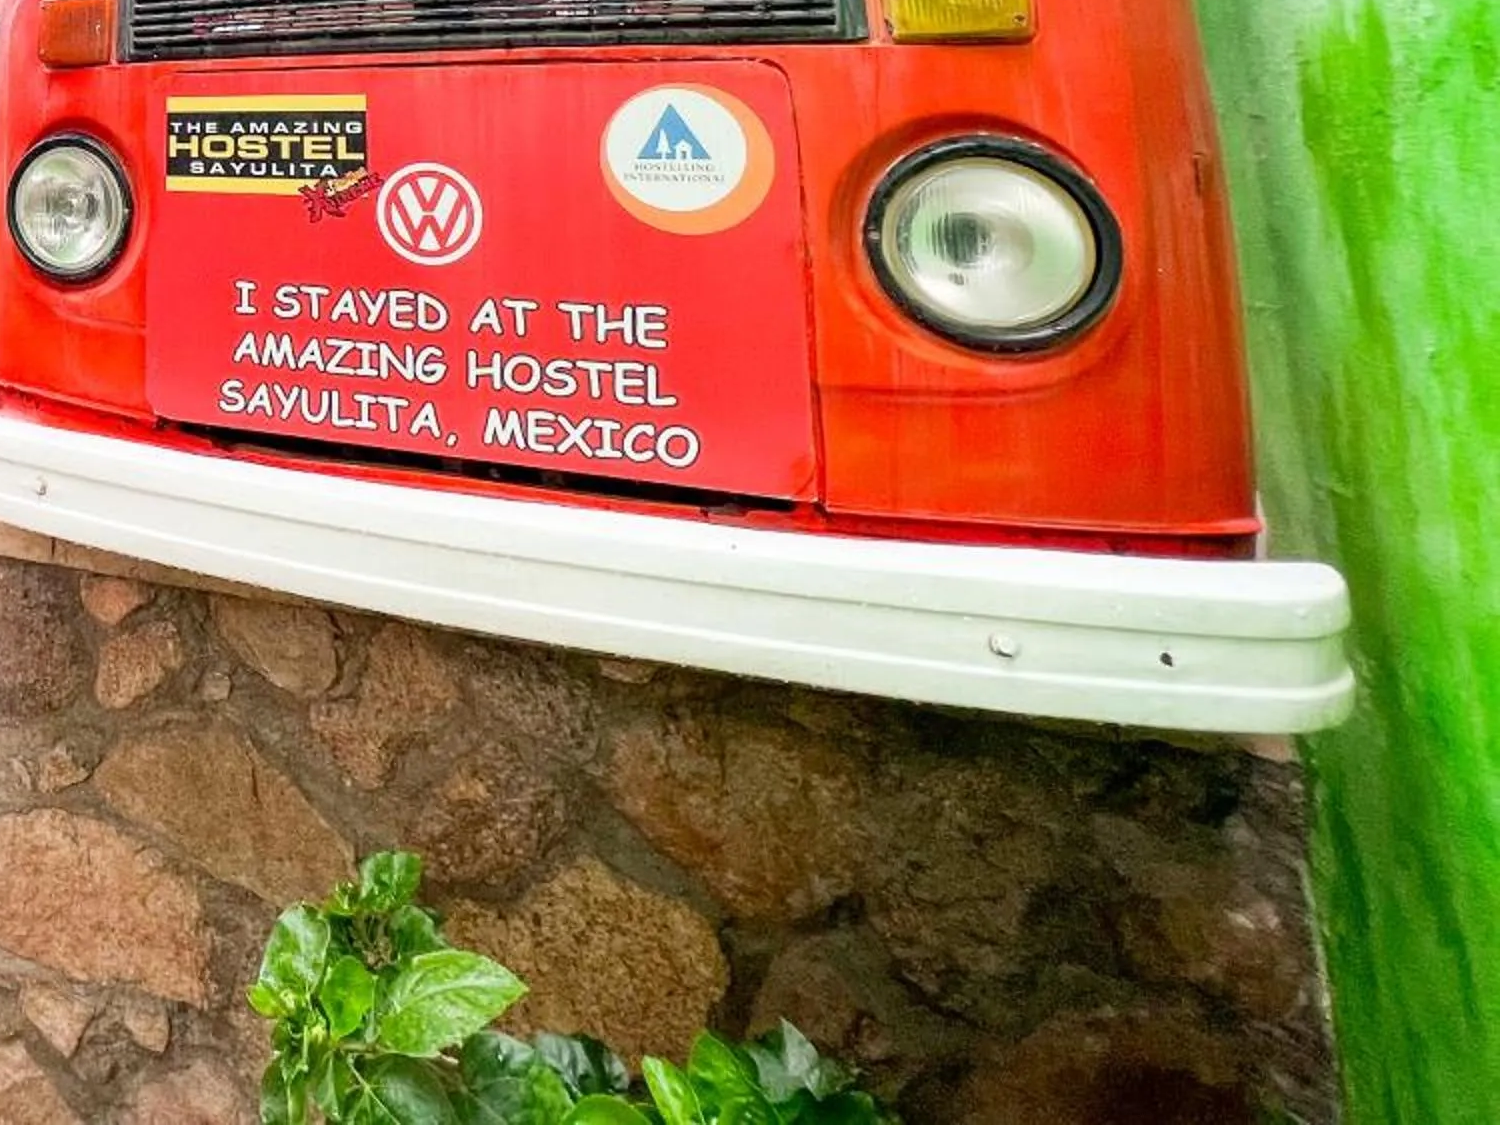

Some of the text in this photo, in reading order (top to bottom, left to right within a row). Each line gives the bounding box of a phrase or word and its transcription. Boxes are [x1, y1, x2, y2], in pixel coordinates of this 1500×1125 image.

[168, 134, 365, 160] HOSTEL
[170, 121, 363, 135] THE AMAZING
[189, 161, 339, 177] SAYULITA
[232, 279, 669, 349] I STAYED AT THE
[232, 331, 678, 408] AMAZING HOSTEL
[218, 378, 701, 470] SAYULITA, MEXICO
